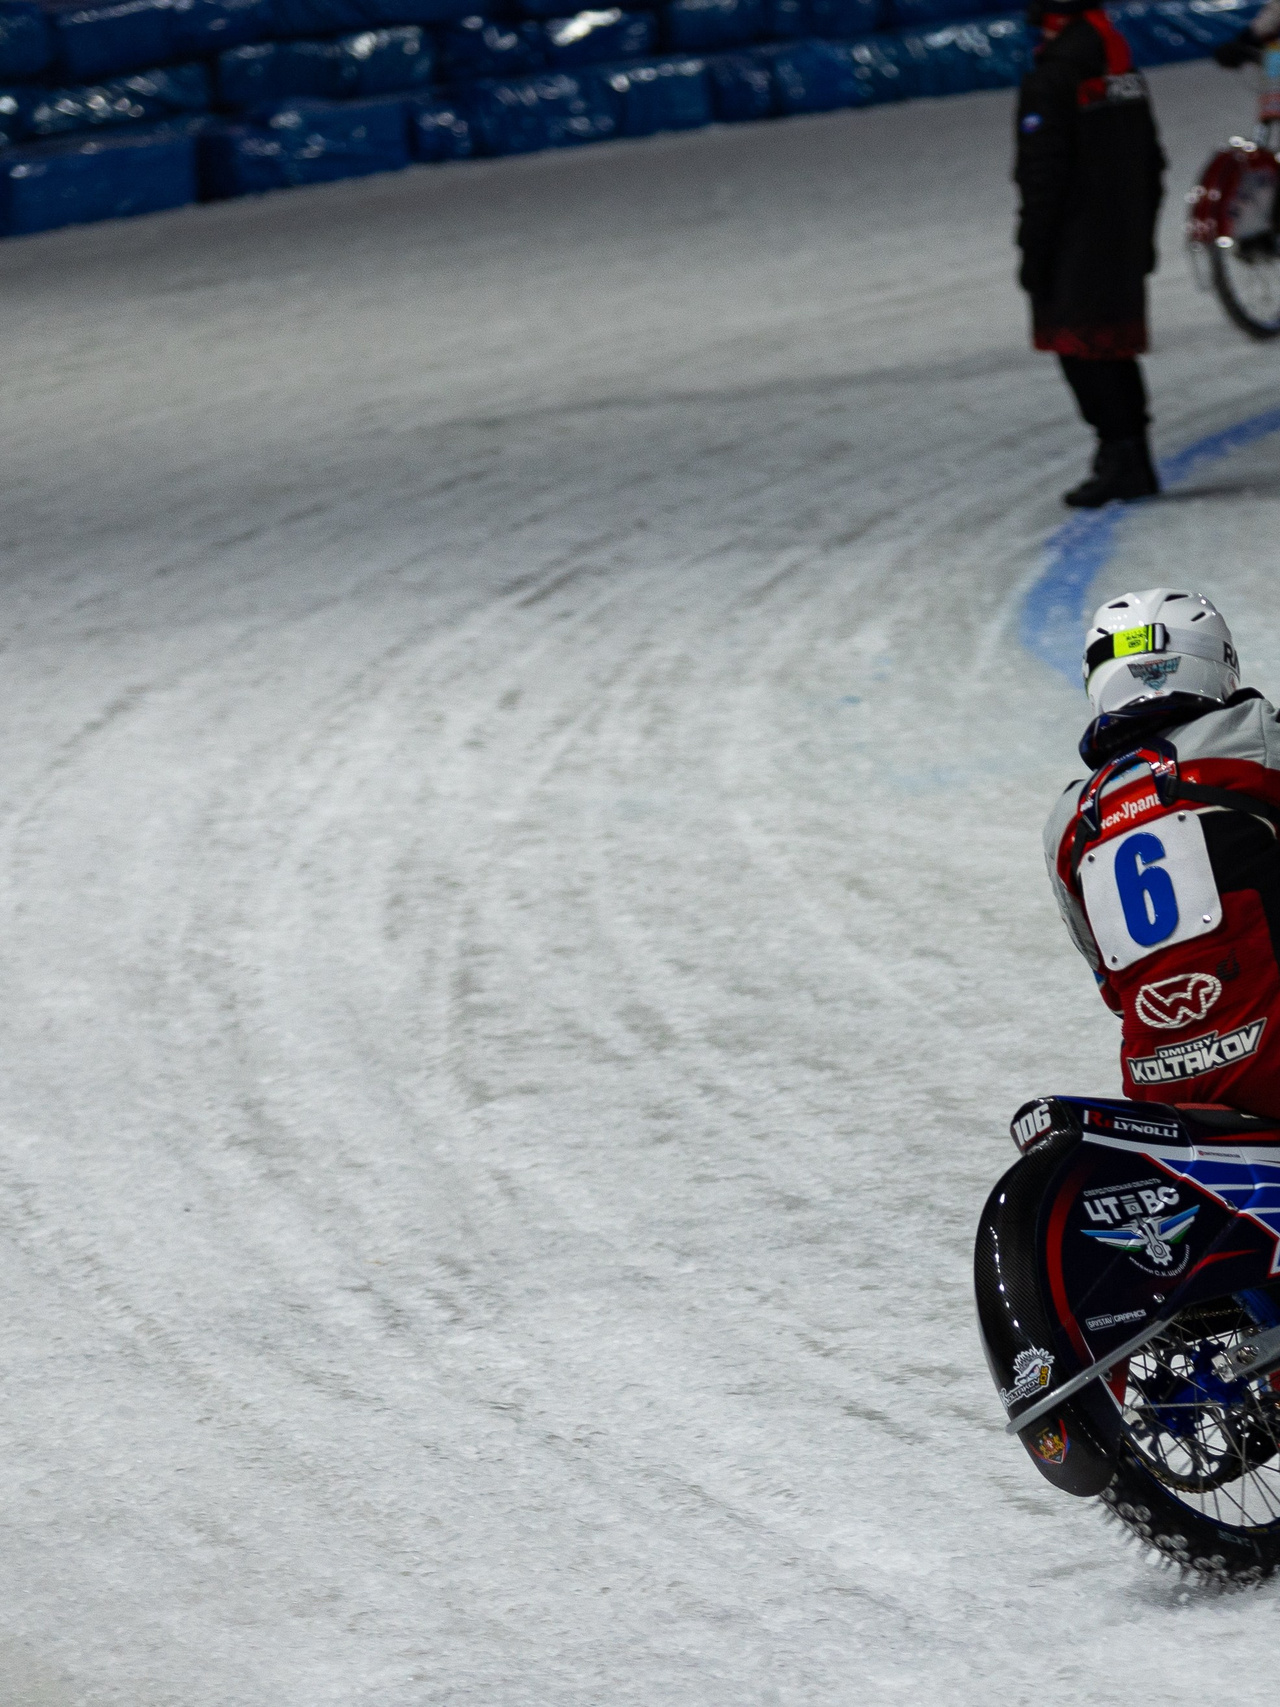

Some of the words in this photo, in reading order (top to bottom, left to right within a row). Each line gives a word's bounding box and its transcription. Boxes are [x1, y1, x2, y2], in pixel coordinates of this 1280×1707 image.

[1114, 831, 1179, 947] 6
[1130, 1025, 1260, 1082] KOLTAKOV
[1158, 1037, 1213, 1058] DMITRY
[1013, 1103, 1052, 1148] 106
